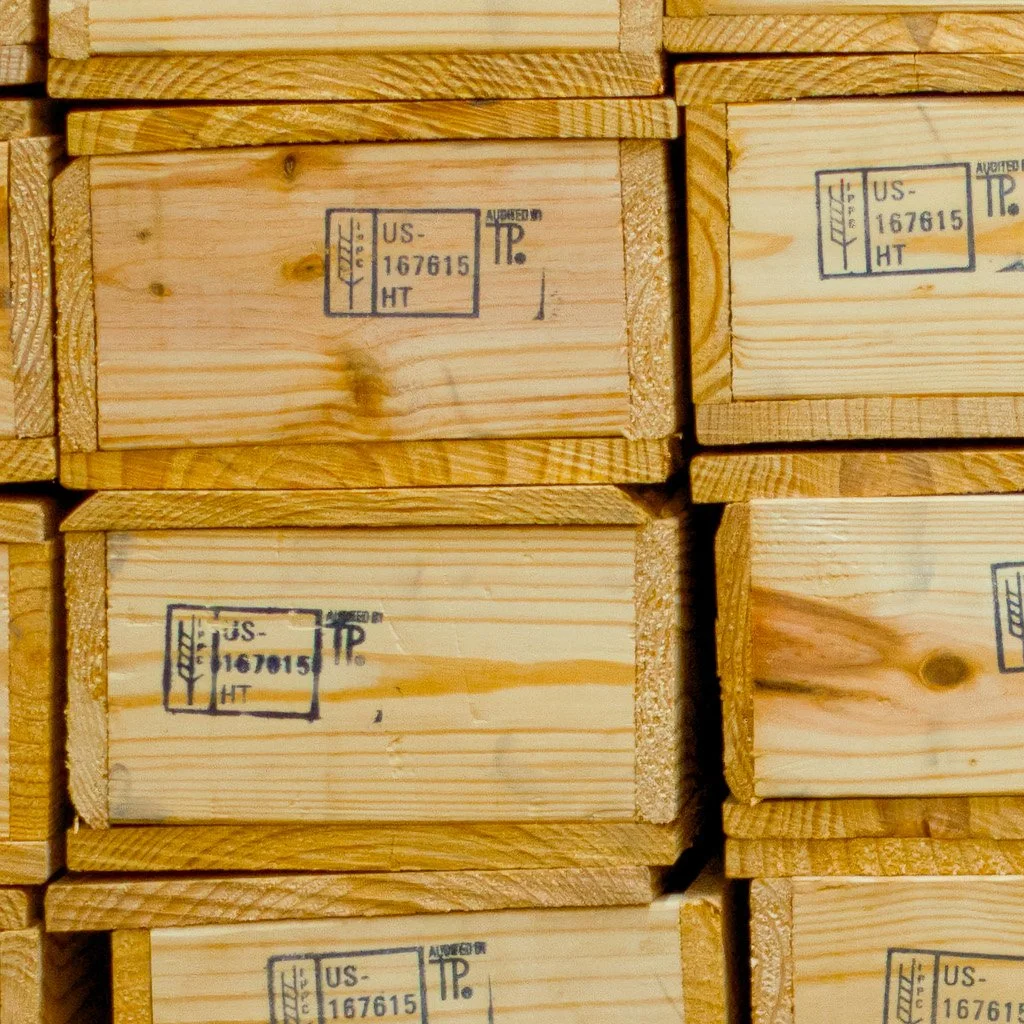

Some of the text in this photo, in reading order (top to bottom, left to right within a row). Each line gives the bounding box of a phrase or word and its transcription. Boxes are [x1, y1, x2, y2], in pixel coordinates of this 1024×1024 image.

[874, 181, 916, 201] US-
[876, 210, 963, 234] 167615
[383, 223, 425, 244] US-
[384, 255, 470, 276] 167615
[877, 244, 906, 266] HT
[381, 287, 413, 308] HT
[221, 685, 252, 704] HT
[325, 965, 369, 988] US-
[944, 965, 986, 987] US-
[329, 994, 417, 1019] 167615
